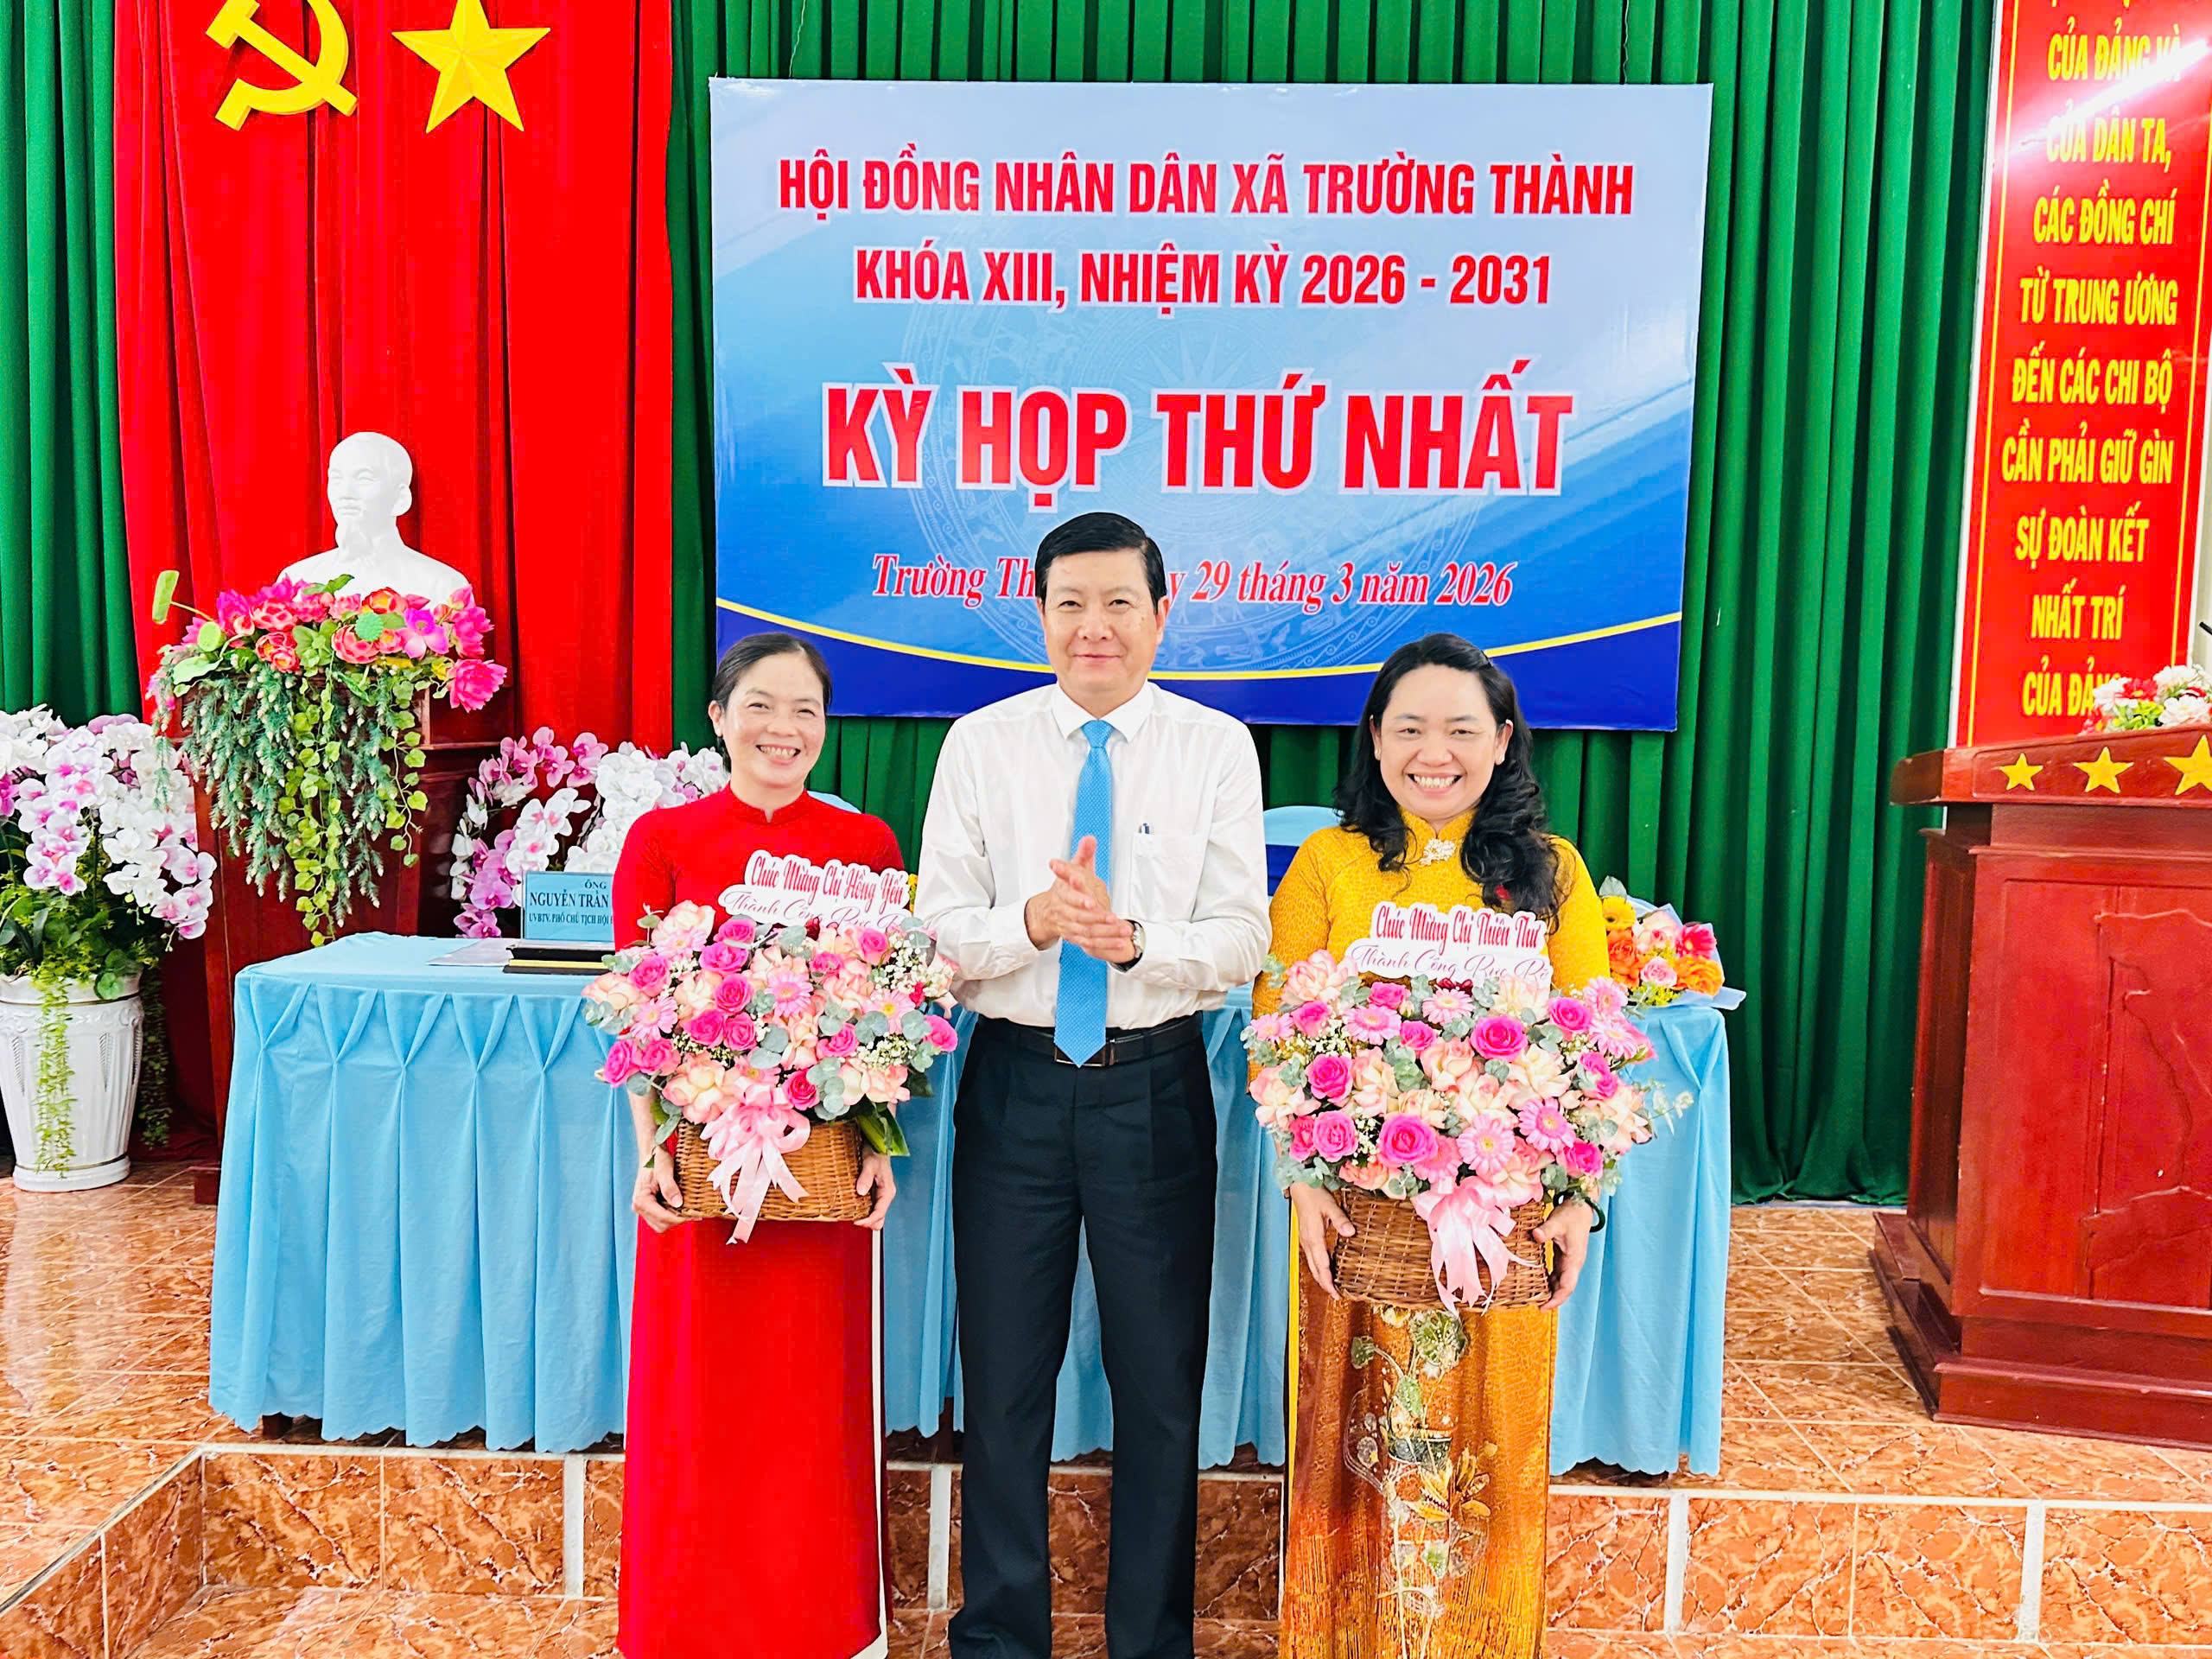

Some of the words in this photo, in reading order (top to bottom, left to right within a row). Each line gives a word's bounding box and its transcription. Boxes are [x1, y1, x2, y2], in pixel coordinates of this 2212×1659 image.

[2048, 16, 2088, 81] CỦA
[2094, 16, 2152, 81] ĐẢNG
[2046, 98, 2087, 162] CỦA
[2092, 105, 2137, 163] DÂN
[2141, 118, 2171, 173] TA,
[780, 148, 849, 221] HỘI
[862, 143, 980, 212] ĐỒNG
[995, 151, 1114, 213] NHÂN
[1129, 152, 1217, 214] DÂN
[1231, 153, 1288, 214] XÃ
[1303, 151, 1474, 215] TRƯỜNG
[1490, 153, 1633, 216] THÀNH
[2033, 186, 2075, 244] CÁC
[2078, 179, 2135, 245] ĐỒNG
[2139, 188, 2178, 245] CHÍ
[857, 239, 969, 302] KHÓA
[983, 251, 1065, 307] XIII,
[1081, 242, 1219, 315] NHIỆM
[1235, 243, 1288, 304] KỲ
[1301, 254, 1405, 304] 2026
[1450, 255, 1549, 304] 2031
[2020, 265, 2050, 324] TỪ
[2052, 278, 2120, 325] TRUNG
[2124, 270, 2178, 326] ƯƠNG
[2012, 340, 2056, 404] ĐẾN
[2059, 346, 2101, 404] CÁC
[2104, 359, 2140, 404] CHI
[2144, 348, 2174, 414] BỘ
[827, 367, 932, 483] KỲ
[960, 390, 1128, 508] HỌP
[1154, 372, 1327, 490] THỨ
[1344, 359, 1573, 490] NHẤT
[2001, 417, 2044, 482] CẦN
[2047, 421, 2096, 483] PHẢI
[2100, 428, 2137, 484] GIỮ
[2139, 428, 2175, 484] GÌN
[2014, 508, 2046, 569] SỰ
[2048, 505, 2104, 562] ĐOÀN
[2107, 500, 2150, 563] KẾT
[874, 555, 985, 607] Trường
[1192, 560, 1230, 601] 29
[1238, 562, 1326, 610] tháng
[1332, 562, 1354, 603] 3
[1360, 566, 1428, 603] năm
[1435, 563, 1513, 604] 2026
[2031, 578, 2086, 639] NHẤT
[2090, 585, 2127, 640] TRÍ
[2022, 654, 2063, 716] CỦA
[2067, 655, 2122, 716] ĐẢ
[578, 890, 609, 908] TRẦN
[583, 878, 607, 890] ÔNG
[723, 891, 779, 915] Thành
[751, 855, 779, 887] Chúc
[783, 860, 820, 906] Mừng
[823, 864, 844, 903] Chị
[844, 868, 876, 913] Hồng
[879, 871, 908, 914] Yến
[581, 914, 596, 925] TỊCH
[597, 913, 609, 925] HỘI
[1376, 905, 1406, 939] Chúc
[1409, 907, 1449, 956] Mừng
[1452, 909, 1475, 951] Chị
[1351, 944, 1410, 969] Thành
[1414, 948, 1458, 979] Công
